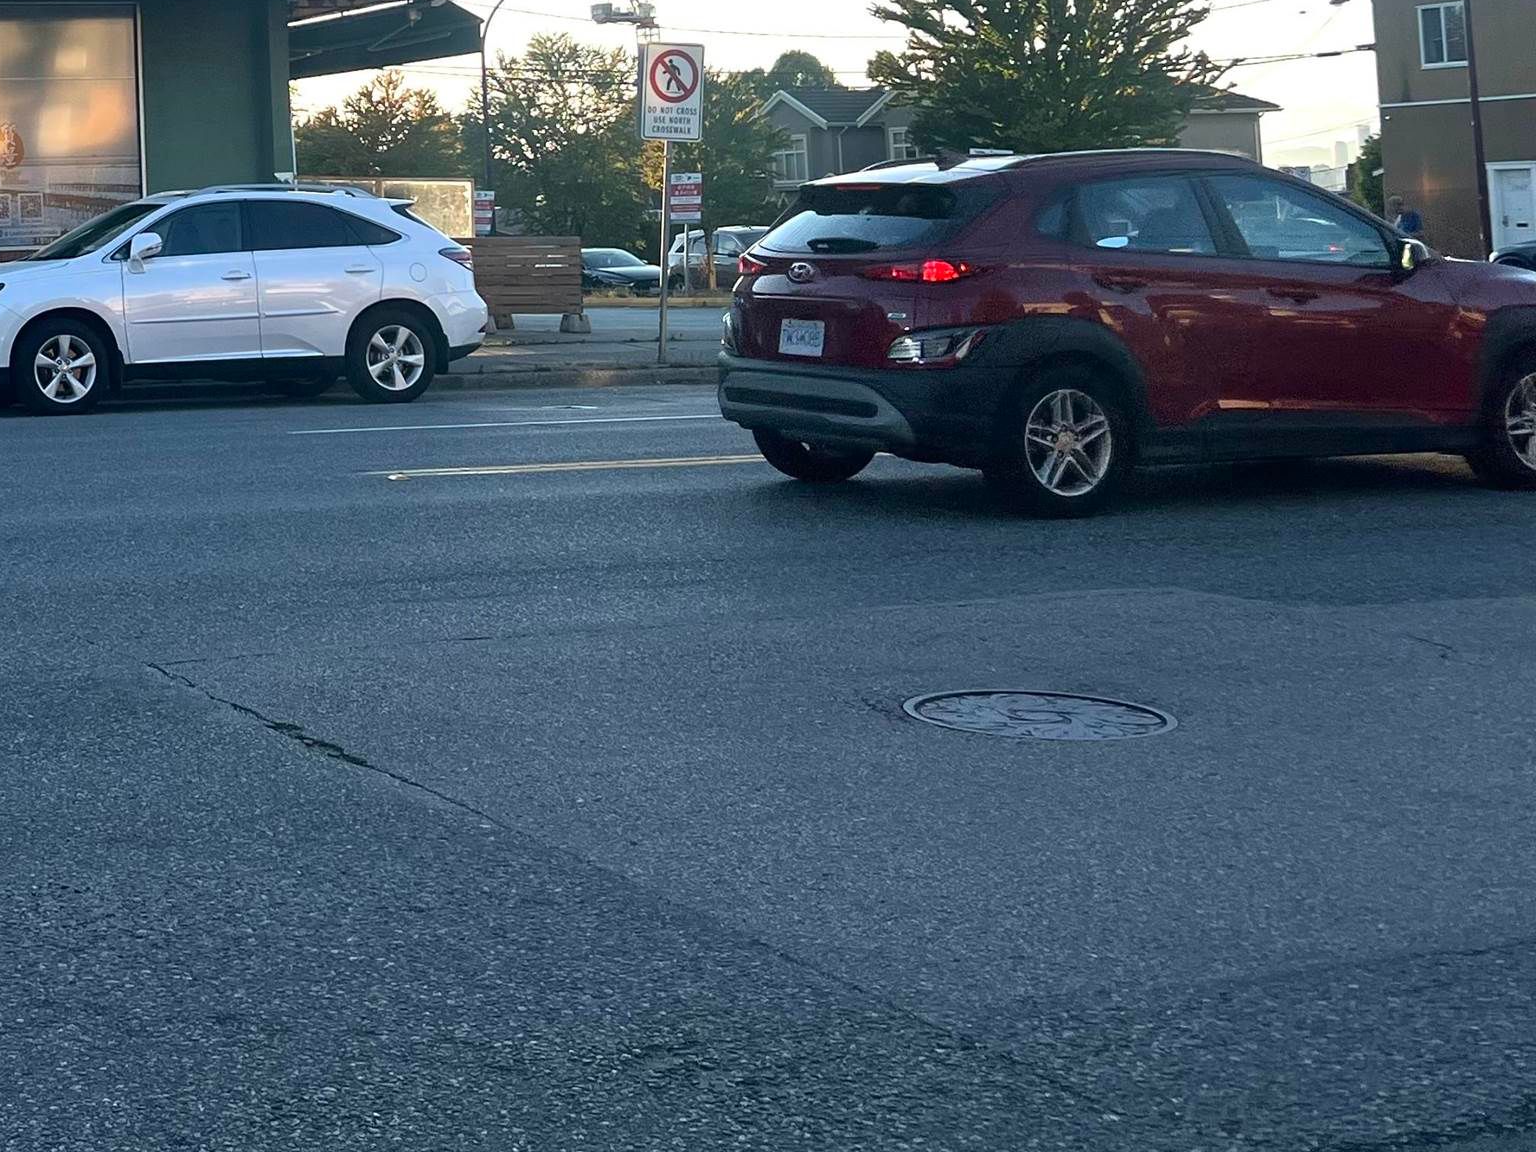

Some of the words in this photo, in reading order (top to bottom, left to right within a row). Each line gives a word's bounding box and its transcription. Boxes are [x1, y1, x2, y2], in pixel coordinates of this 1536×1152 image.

[648, 106, 658, 114] DO
[661, 106, 673, 114] NOT
[676, 107, 697, 115] CROSS
[653, 116, 665, 124] USE
[669, 116, 691, 125] NORTH
[652, 125, 691, 134] CROSSWALK
